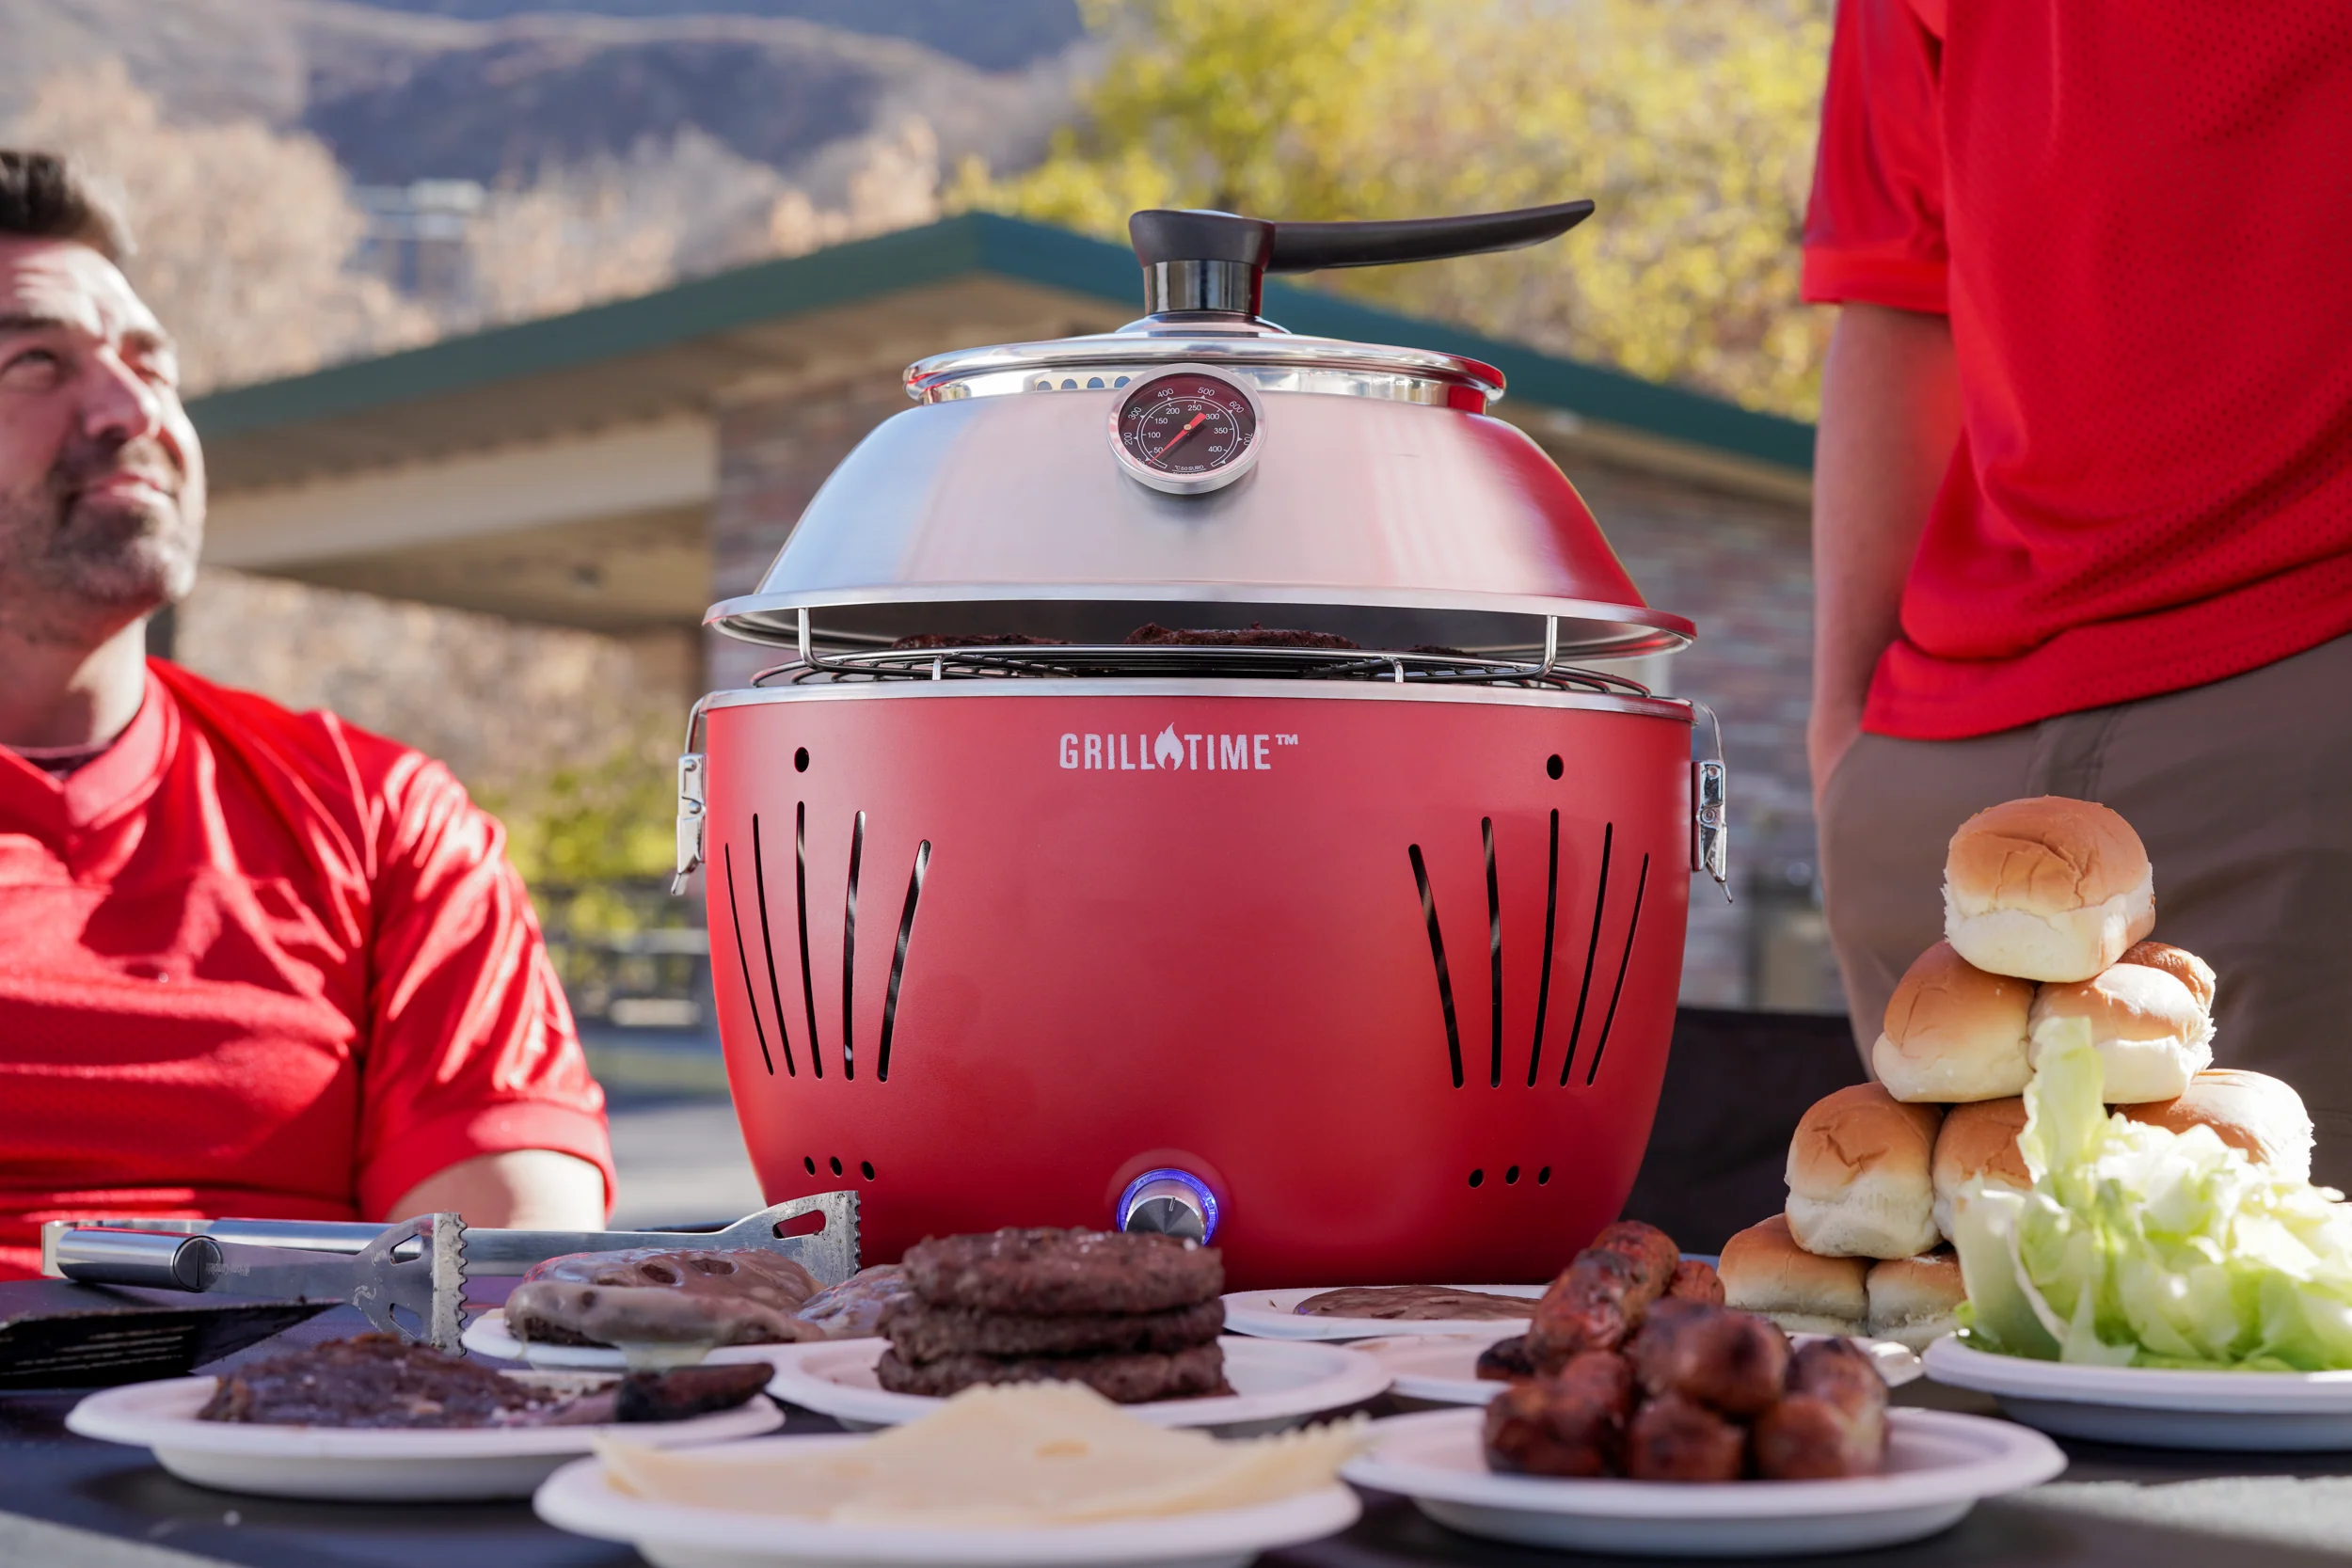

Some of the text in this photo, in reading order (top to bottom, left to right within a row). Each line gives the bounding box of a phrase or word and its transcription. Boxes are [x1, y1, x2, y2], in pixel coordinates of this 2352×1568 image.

[1157, 388, 1174, 398] 400
[1197, 387, 1215, 397] 500
[1127, 406, 1142, 420] 300
[1229, 401, 1245, 414] 600
[1124, 432, 1133, 446] 200
[1059, 733, 1155, 770] GRILL
